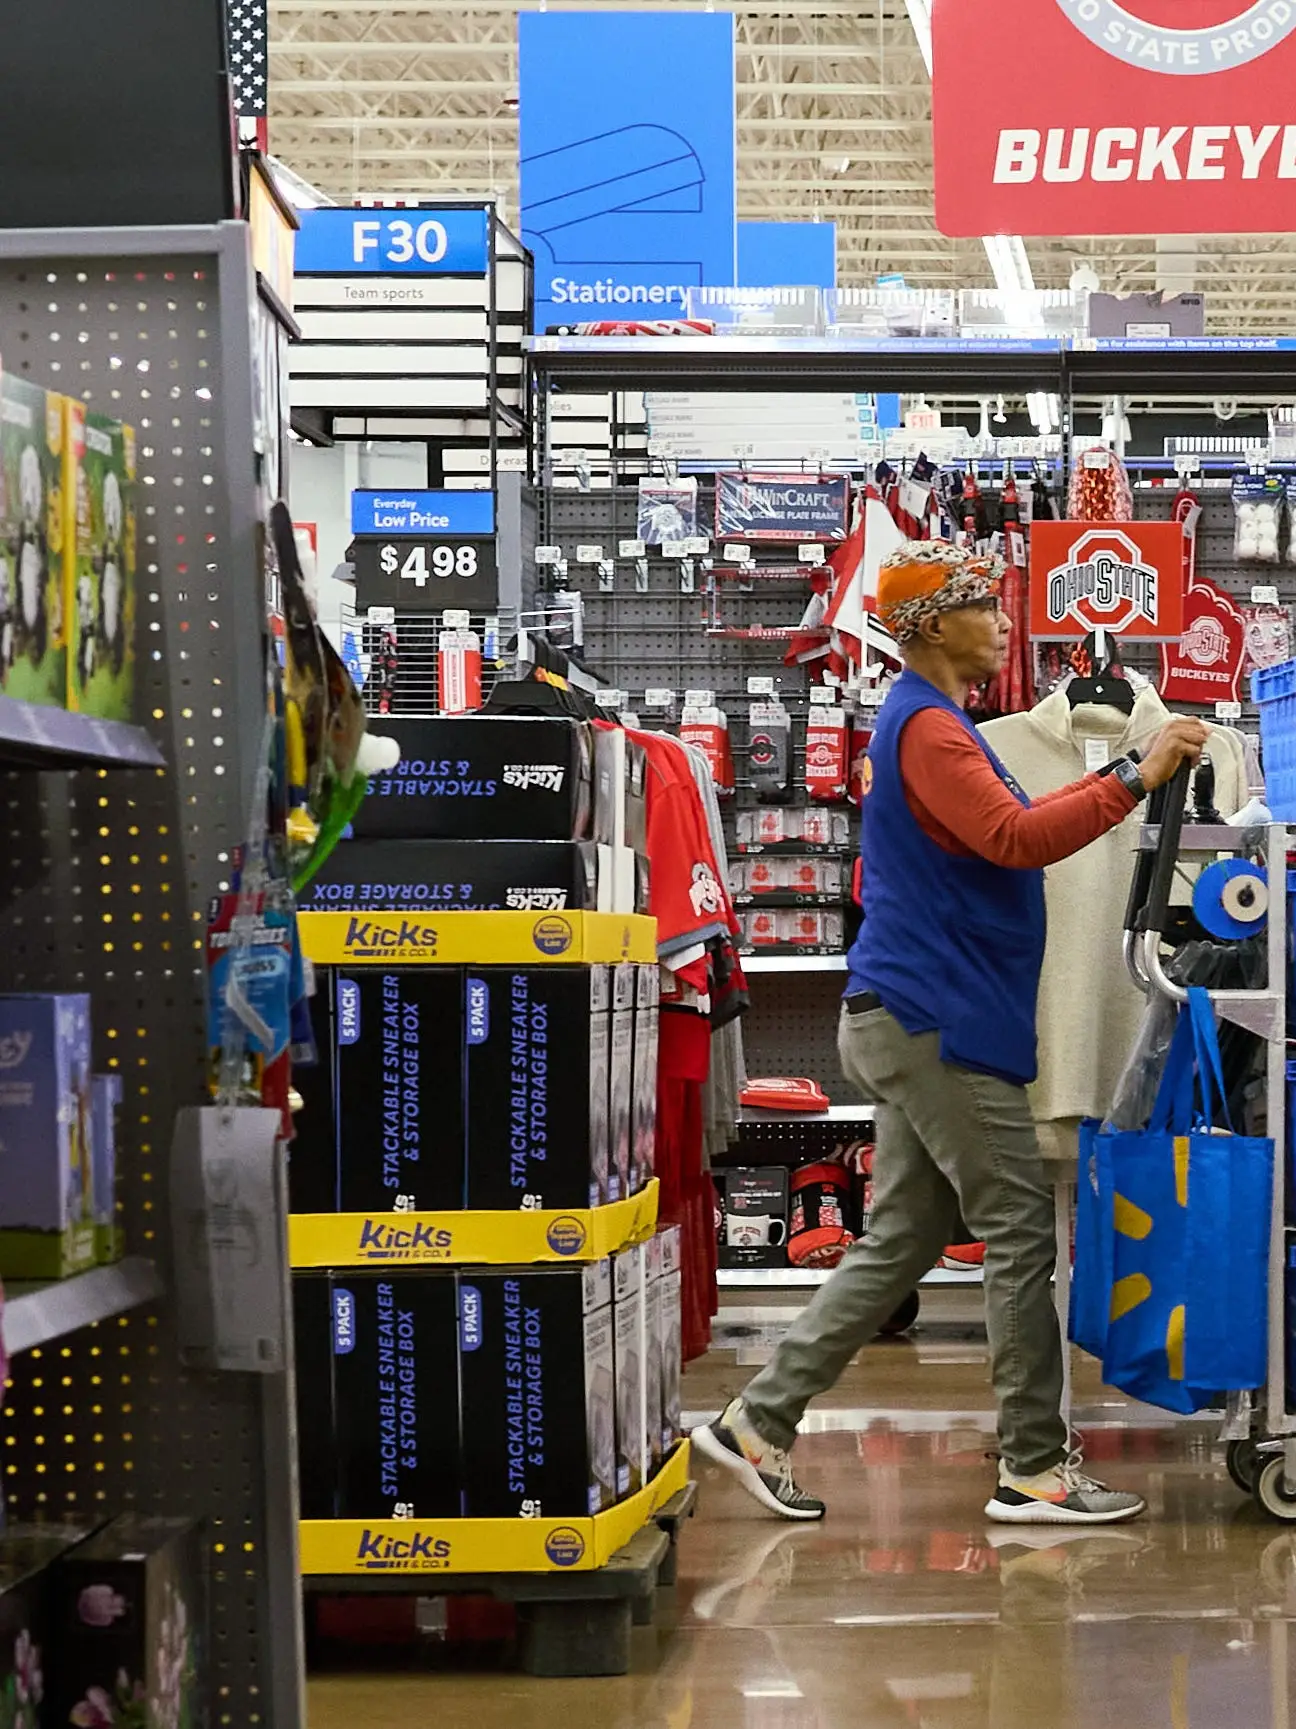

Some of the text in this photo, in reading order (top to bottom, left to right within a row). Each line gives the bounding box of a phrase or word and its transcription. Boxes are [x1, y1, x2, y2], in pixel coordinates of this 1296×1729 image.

[1104, 21, 1200, 65] STATE
[344, 286, 424, 301] Team sports
[550, 278, 691, 311] Stationery
[1110, 339, 1124, 348] for
[1125, 339, 1166, 348] assistance
[1168, 339, 1186, 348] with
[1187, 339, 1210, 348] items
[1224, 339, 1238, 348] the
[1240, 340, 1254, 349] top
[911, 414, 934, 428] EXIT
[373, 498, 416, 511] Everyday
[374, 512, 450, 528] Low Price
[786, 510, 810, 520] PLATE
[810, 511, 840, 521] FRAME
[1050, 557, 1156, 620] OHIO STATE
[1171, 666, 1230, 683] BUCKEYES
[380, 780, 496, 796] STACKABLE
[314, 884, 473, 900] & STORAGE BOX
[342, 987, 356, 1037] 5 PACK
[471, 986, 484, 1036] 5 PACK
[382, 974, 400, 1188] STACKABLE SNEAKER
[402, 1002, 420, 1161] & STORAGE BOX
[511, 974, 528, 1188] STACKABLE SNEAKER
[530, 1002, 548, 1161] & STORAGE BOX
[337, 1296, 351, 1346] 5 PACK
[464, 1293, 478, 1343] 5 PACK
[376, 1282, 398, 1496] STACKABLE SNEAKER
[398, 1310, 418, 1469] & STORAGE BOX
[504, 1280, 525, 1494] STACKABLE SNEAKER
[524, 1307, 544, 1466] & STORAGE BOX
